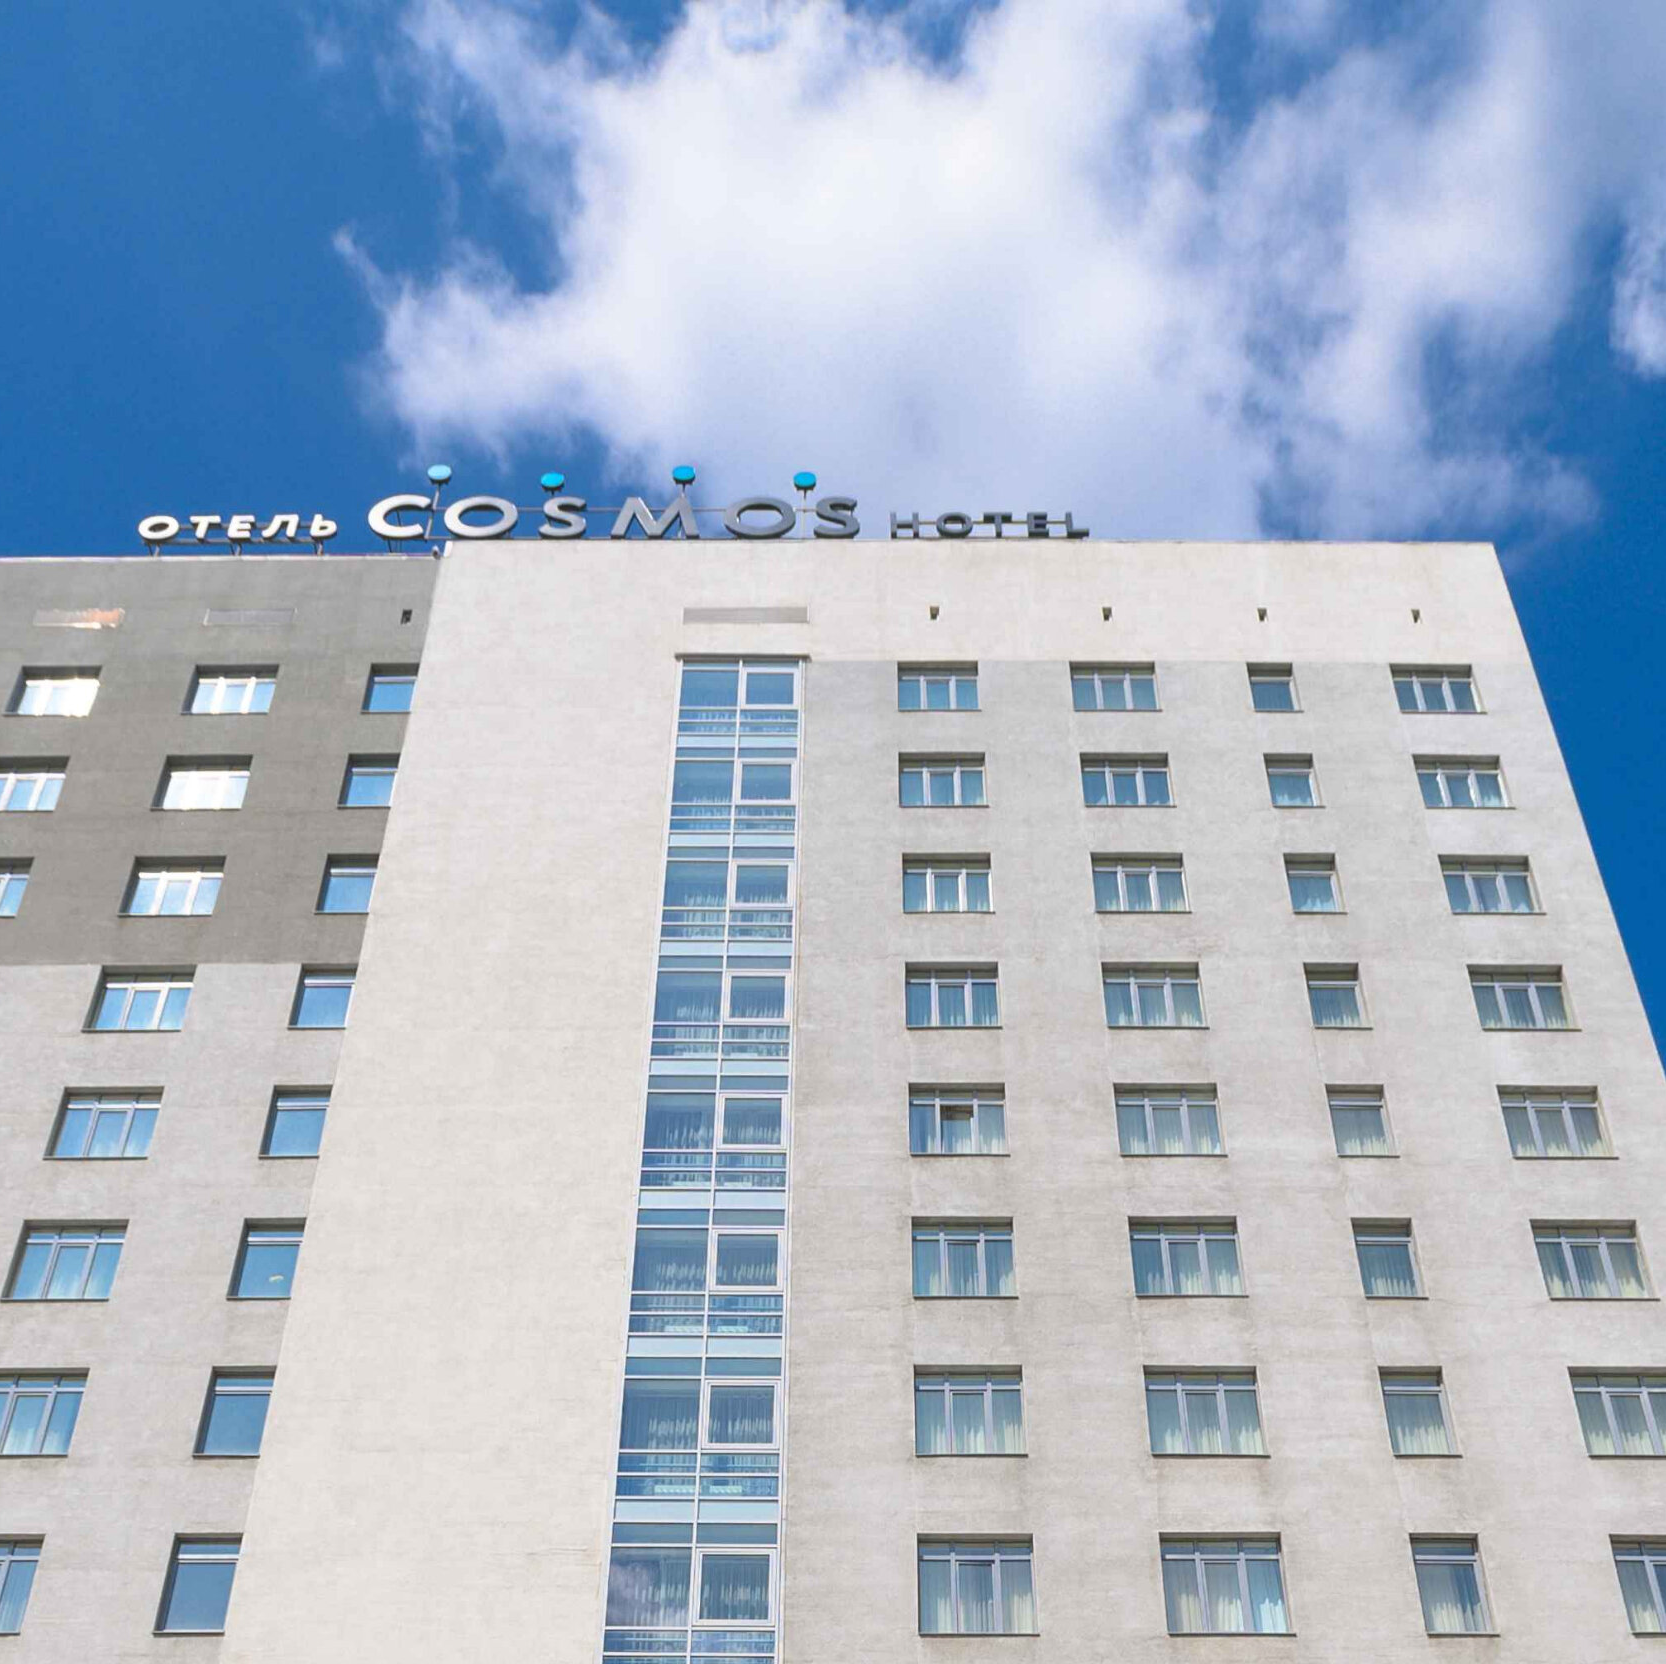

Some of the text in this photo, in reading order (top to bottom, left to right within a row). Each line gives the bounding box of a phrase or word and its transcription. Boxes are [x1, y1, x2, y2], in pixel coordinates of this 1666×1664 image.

[138, 495, 1090, 540] ОТЕЛЬ COSMOS HOTEL
